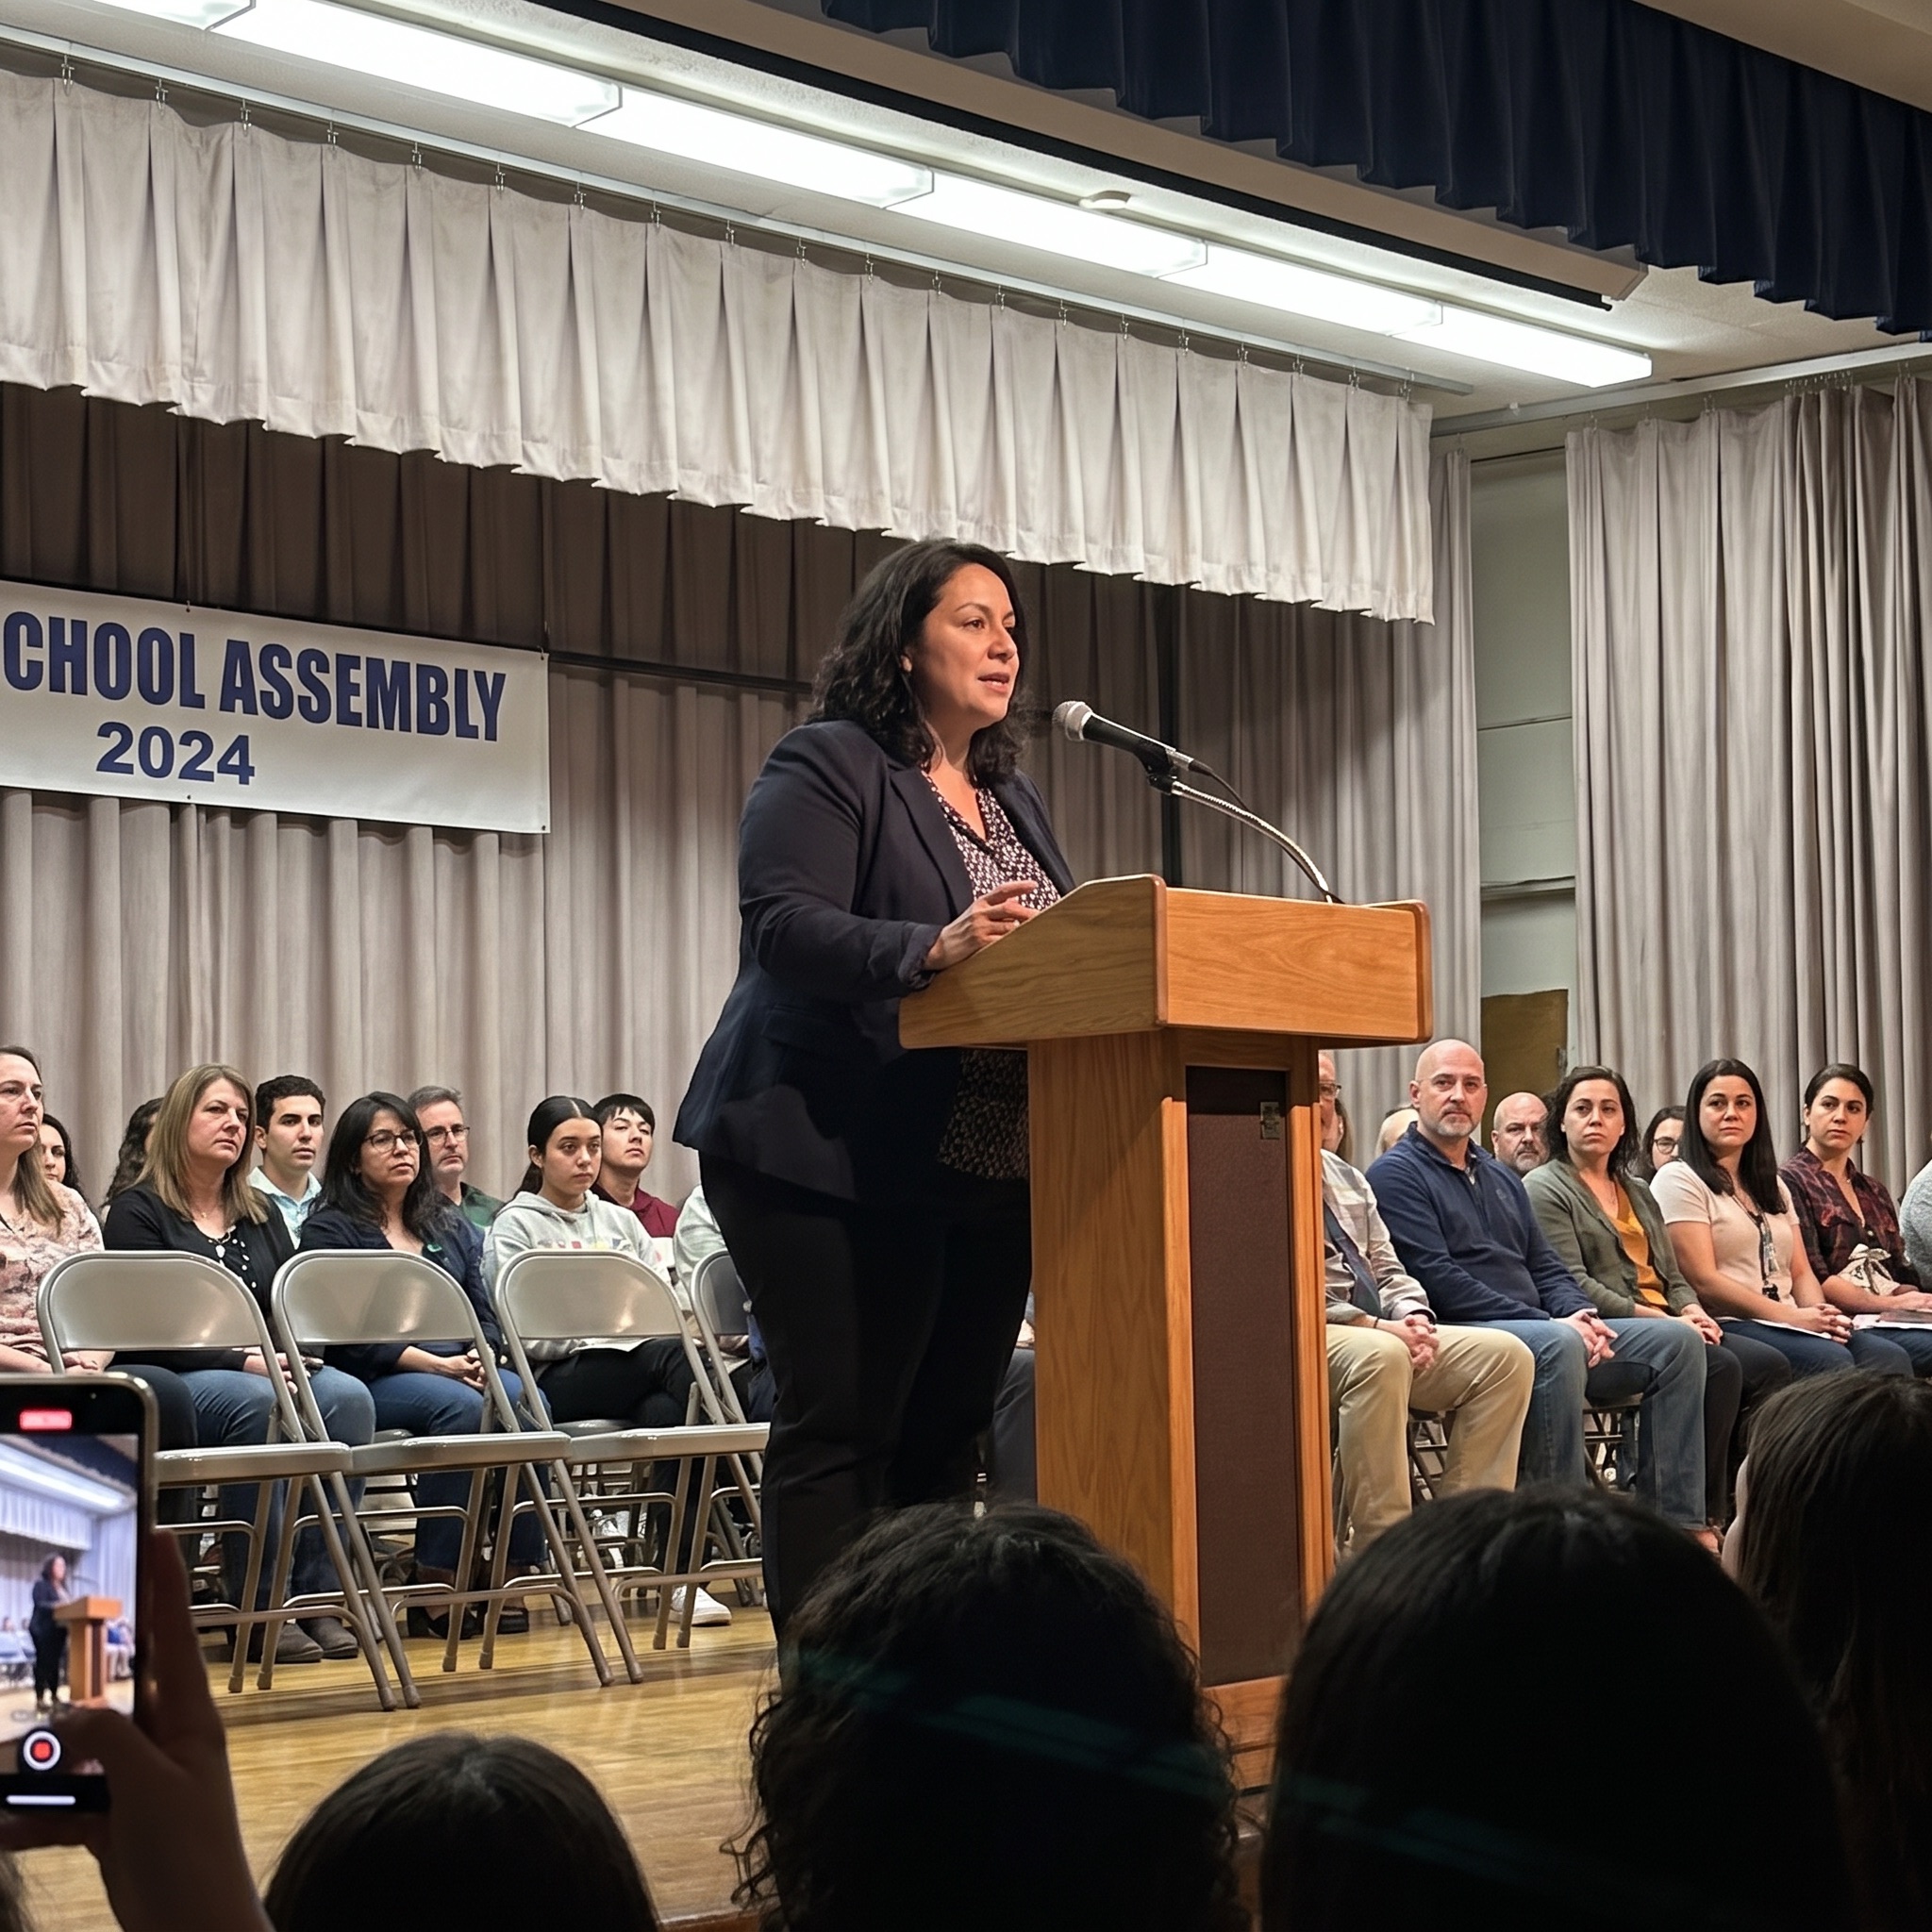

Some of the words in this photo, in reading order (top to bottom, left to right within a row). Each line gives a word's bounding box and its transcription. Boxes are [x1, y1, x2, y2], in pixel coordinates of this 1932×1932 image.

[4, 611, 205, 708] CHOOL
[220, 639, 506, 741] ASSEMBLY
[96, 722, 256, 786] 2024
